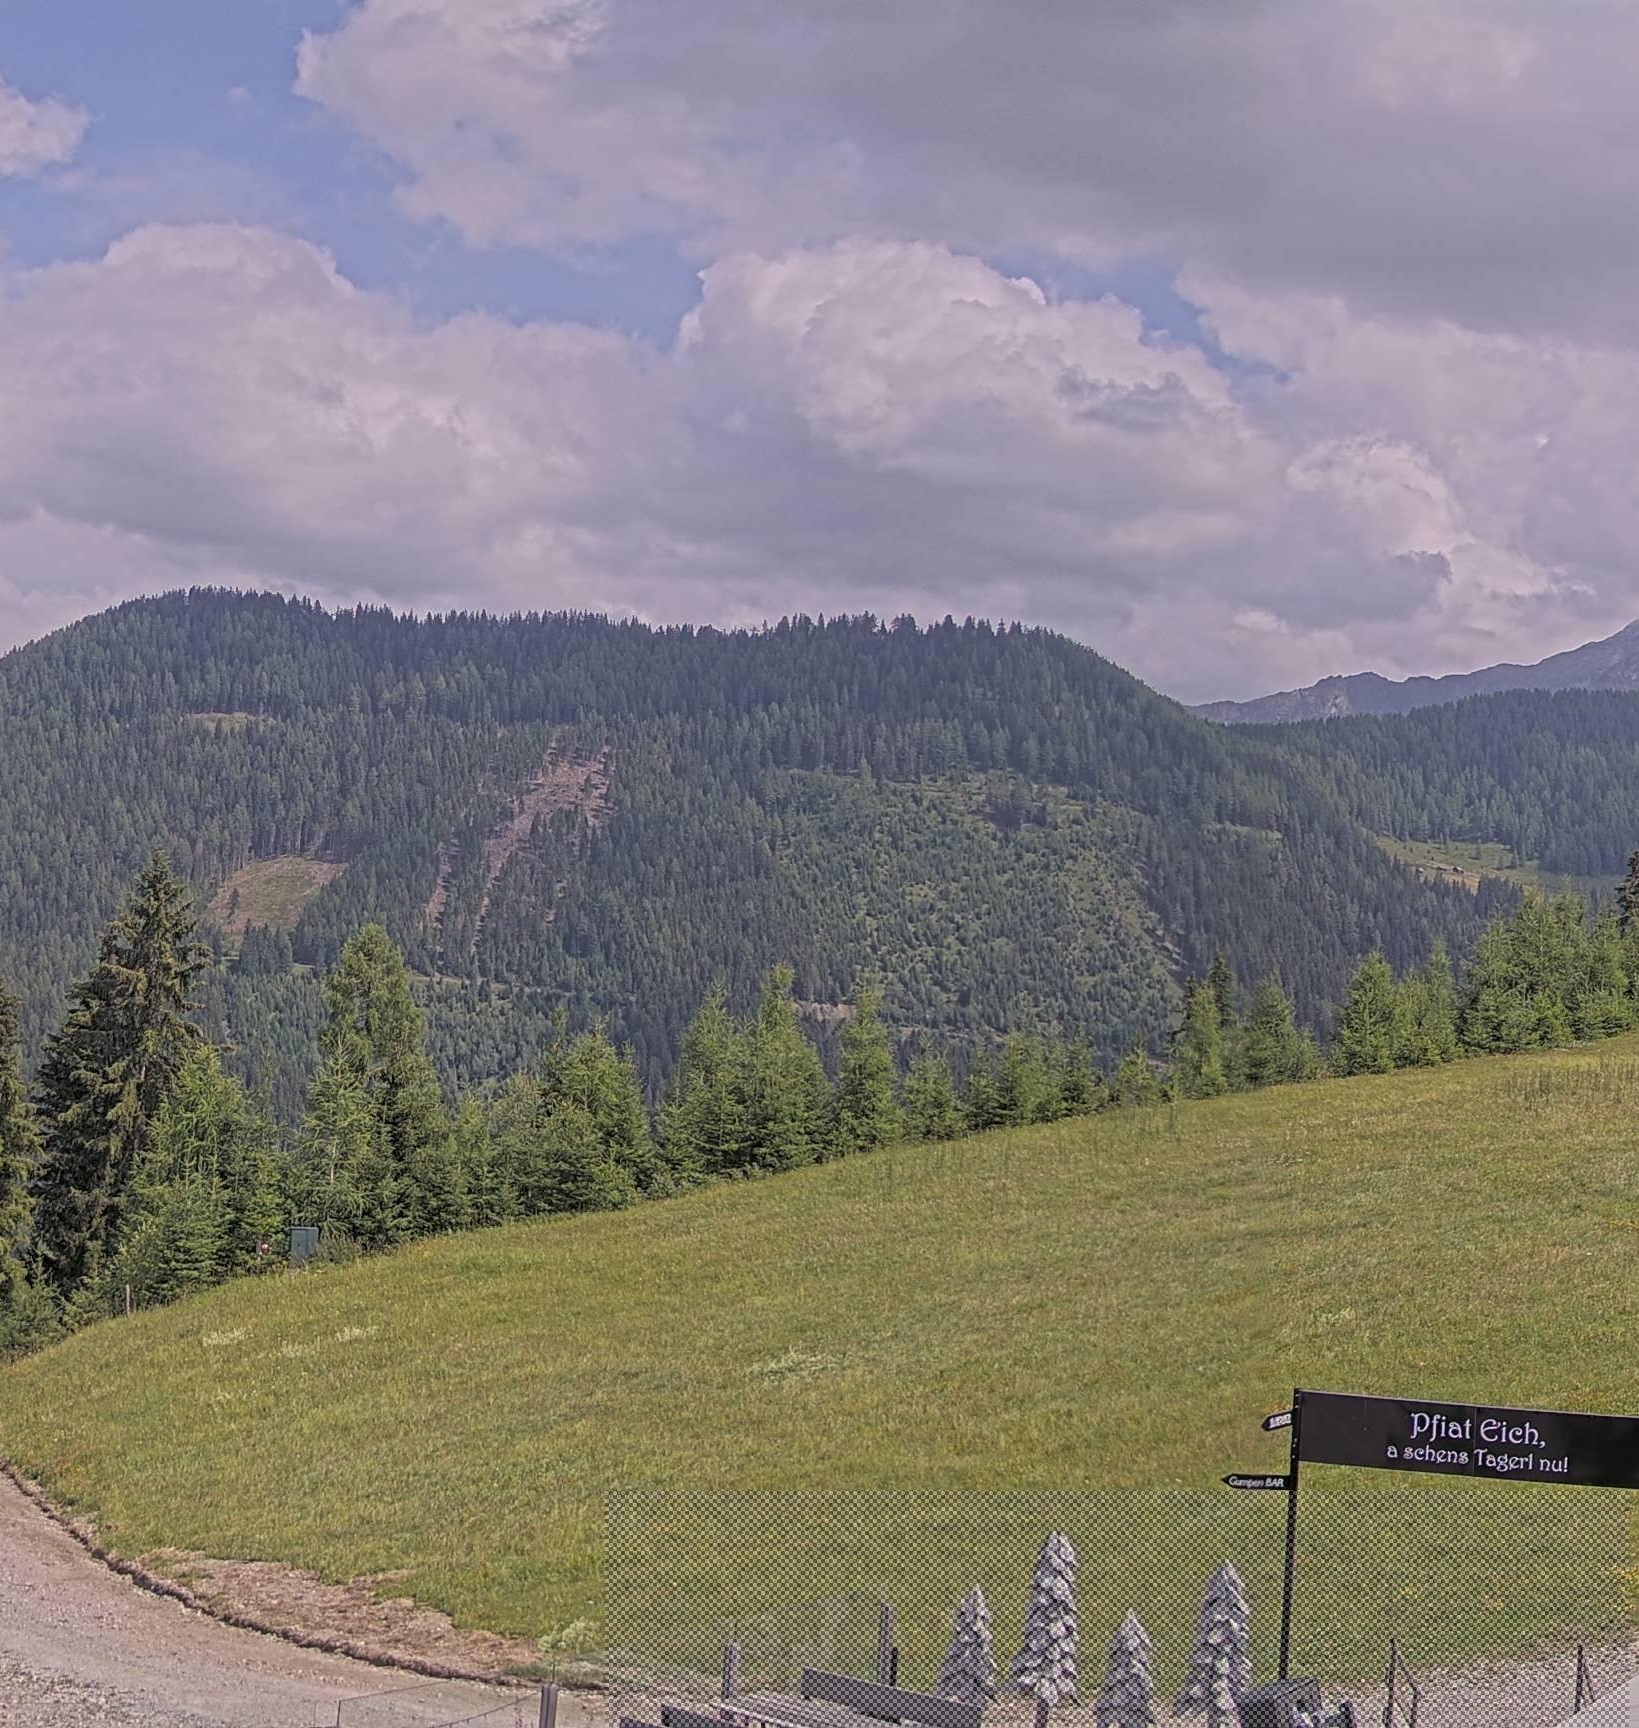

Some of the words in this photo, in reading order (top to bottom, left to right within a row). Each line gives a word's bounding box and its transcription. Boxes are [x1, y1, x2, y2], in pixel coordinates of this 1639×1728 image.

[1410, 1412, 1472, 1441] Pfiat
[1480, 1418, 1546, 1448] Eich,
[1387, 1445, 1398, 1458] a
[1403, 1445, 1470, 1464] schens
[1473, 1449, 1533, 1472] Tagerl
[1539, 1457, 1568, 1473] nu!
[1265, 1478, 1284, 1488] BAR
